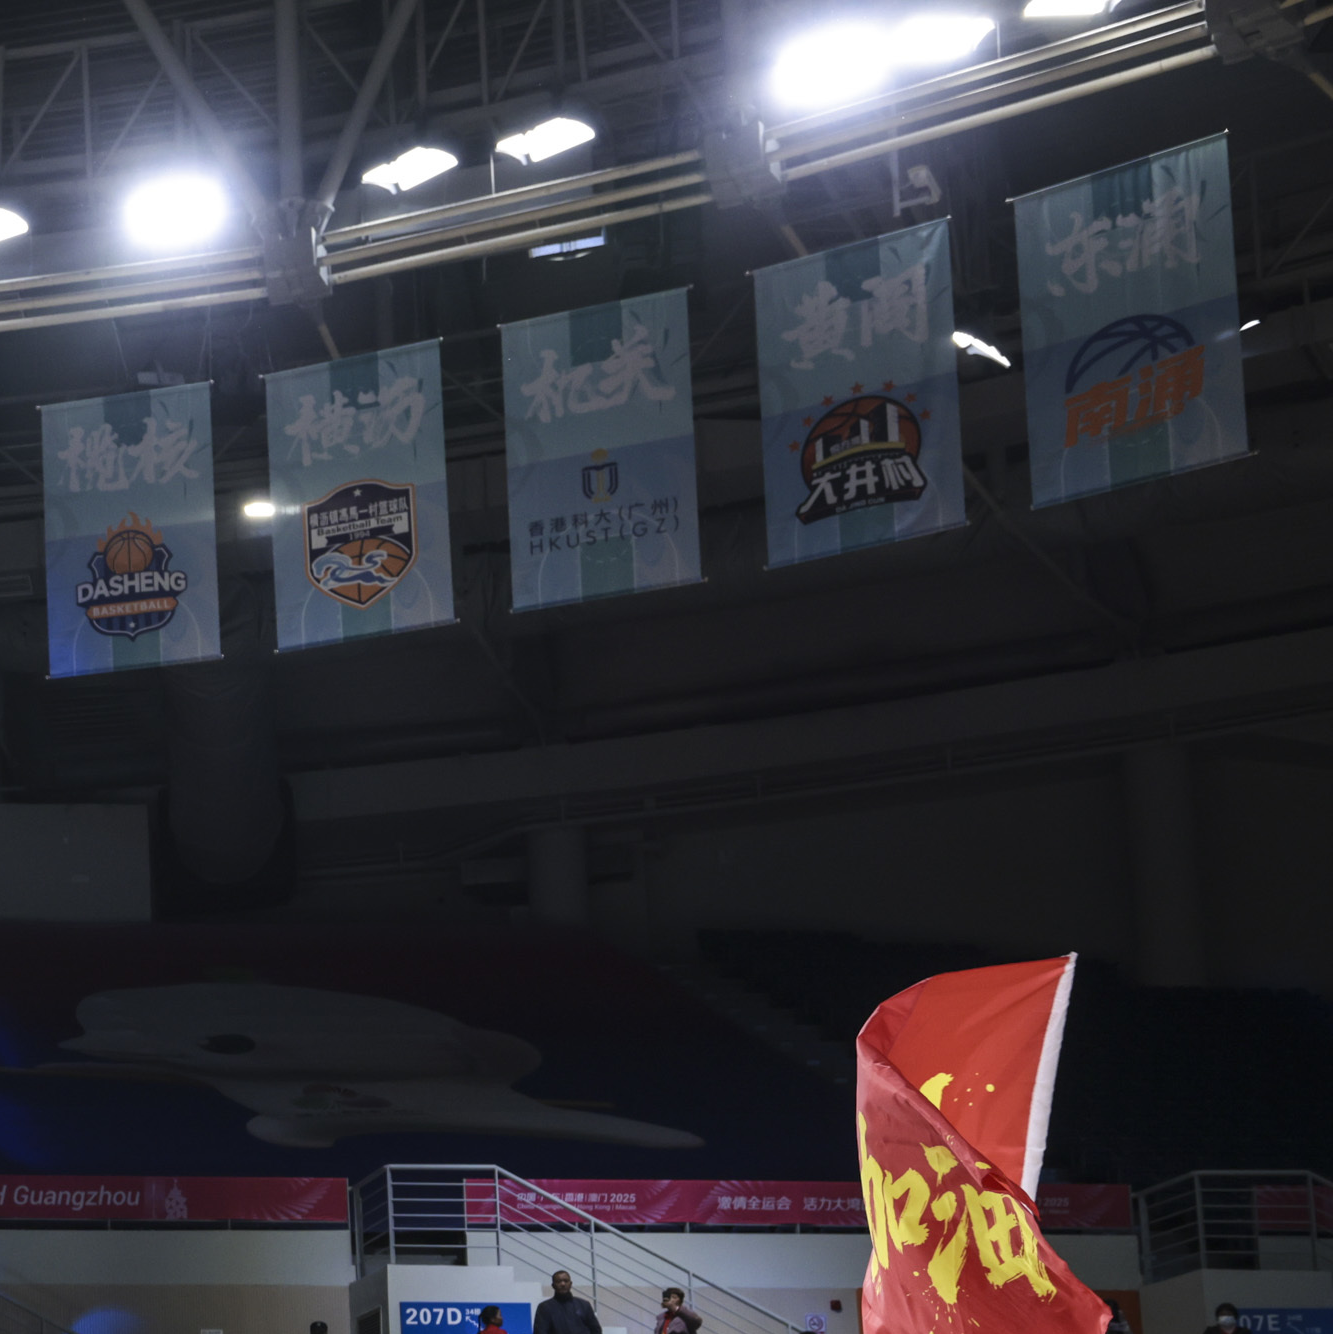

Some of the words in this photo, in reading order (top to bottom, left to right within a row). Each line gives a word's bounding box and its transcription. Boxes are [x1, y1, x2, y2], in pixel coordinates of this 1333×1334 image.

[799, 455, 926, 515] 大井村
[317, 519, 371, 538] Basketball
[375, 514, 404, 526] Team
[77, 571, 187, 604] DASHENG
[92, 598, 172, 619] BASKETBALL
[13, 1184, 141, 1210] Guangzhou
[610, 1193, 637, 1204] 2025
[405, 1307, 463, 1326] 207D
[1238, 1313, 1282, 1331] 07E
